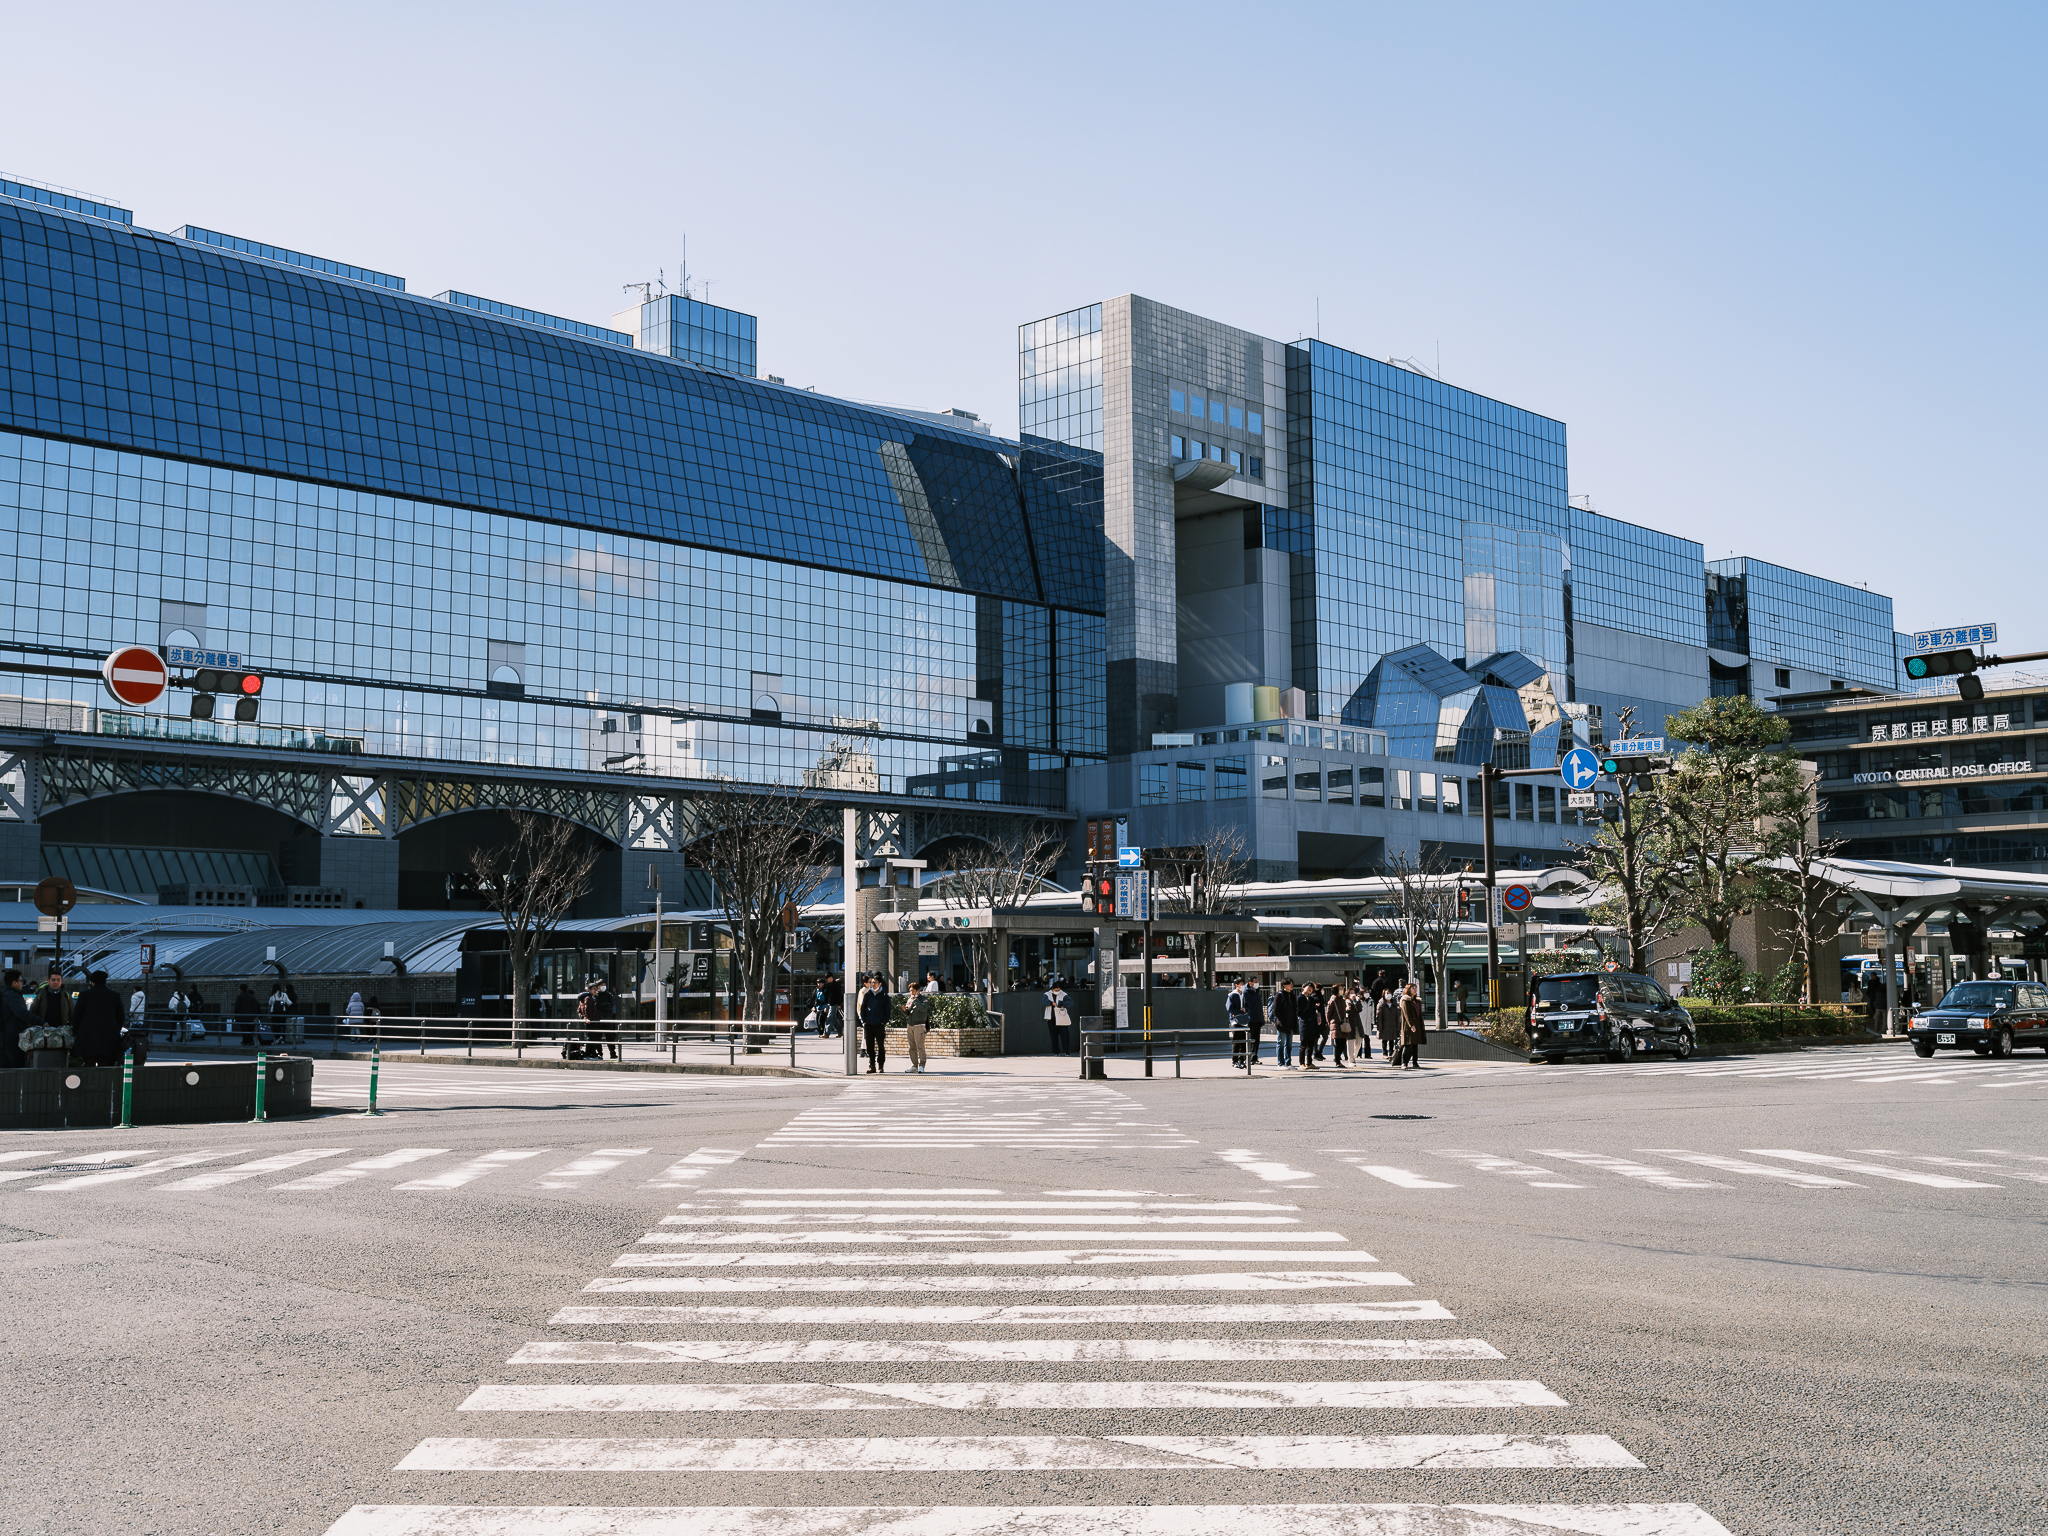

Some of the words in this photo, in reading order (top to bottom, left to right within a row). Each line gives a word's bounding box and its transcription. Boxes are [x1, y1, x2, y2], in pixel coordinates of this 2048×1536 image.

[1917, 626, 1994, 649] 歩車分離信号
[170, 648, 239, 667] 歩車分離信号
[1871, 714, 2010, 740] 京都中央郵便局
[1613, 740, 1661, 753] 歩車分離信号
[1853, 770, 1892, 783] KYOTO
[1895, 767, 1949, 781] CENTRAL
[1952, 764, 1985, 777] POST
[1988, 761, 2031, 774] OFFICE
[1570, 796, 1592, 805] 大型等
[1120, 879, 1128, 914] 斜め横断専用
[1138, 936, 1165, 947] Pta
